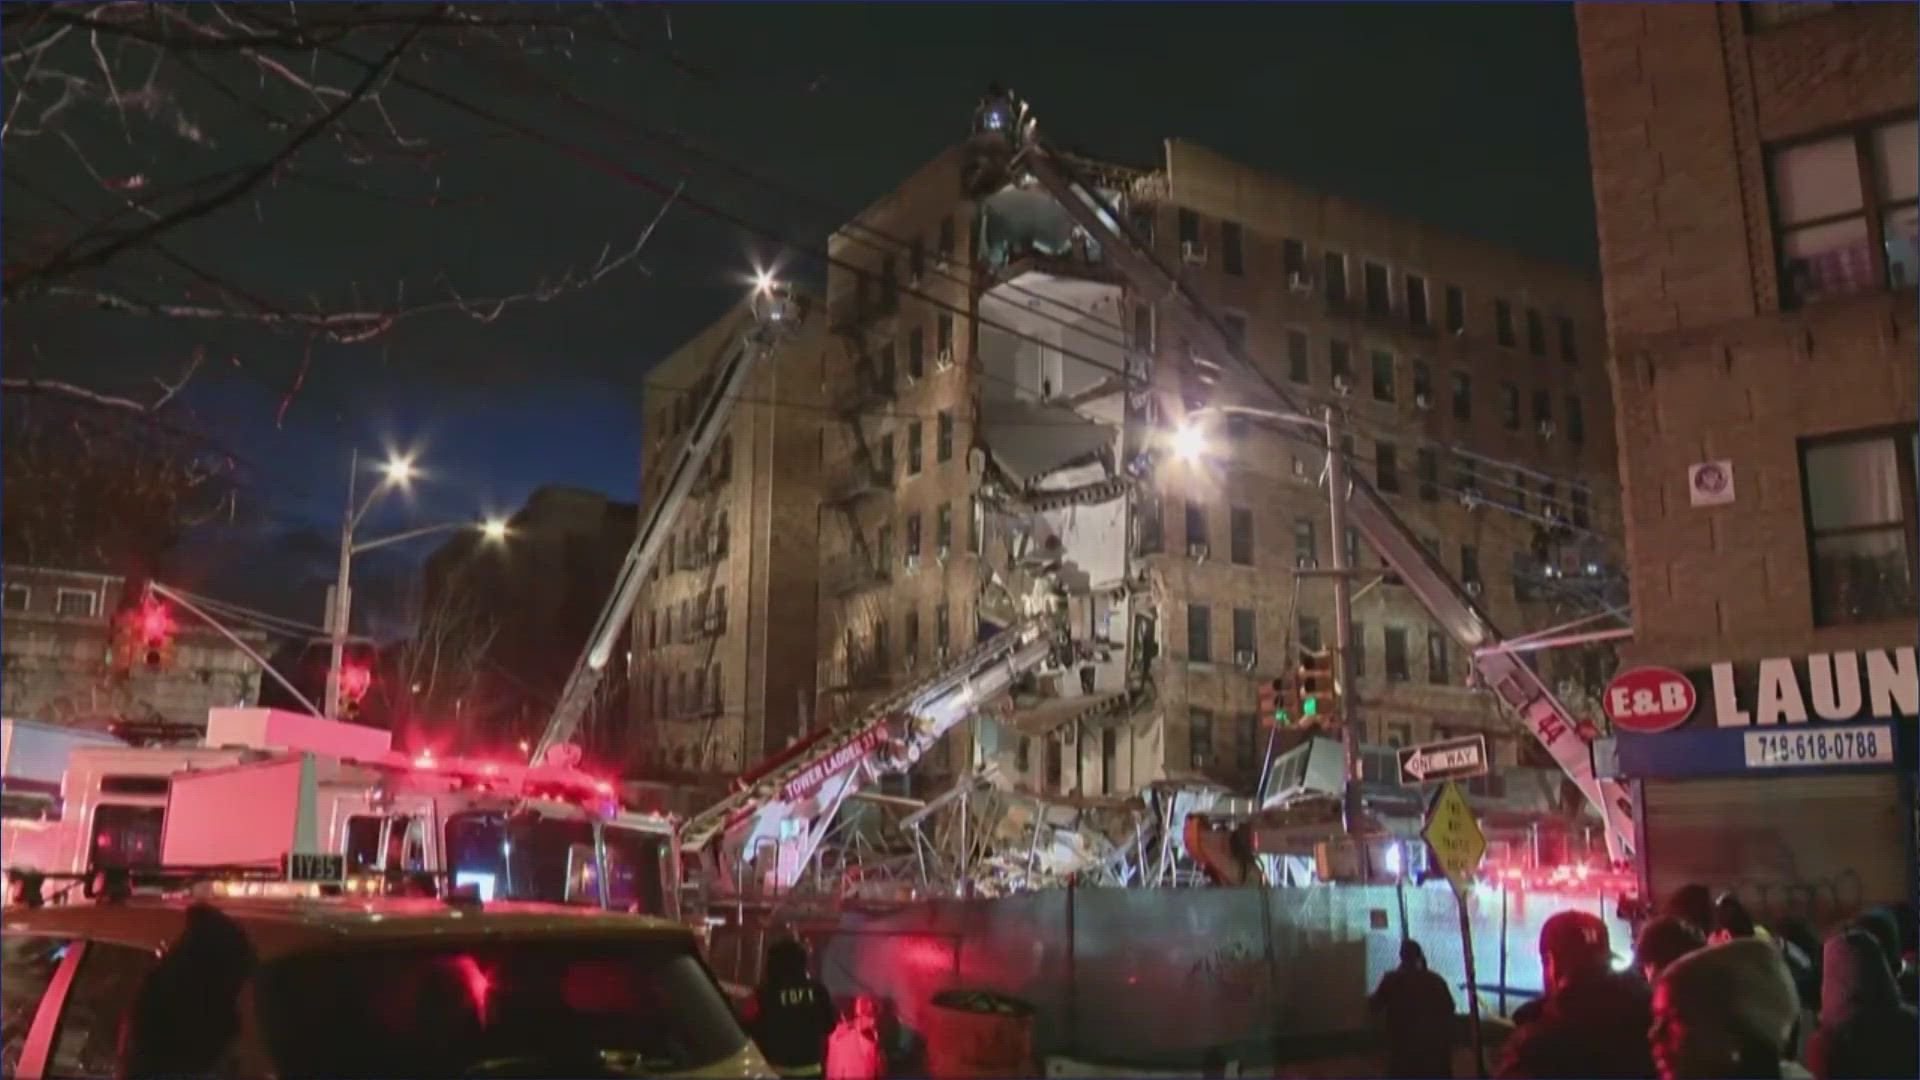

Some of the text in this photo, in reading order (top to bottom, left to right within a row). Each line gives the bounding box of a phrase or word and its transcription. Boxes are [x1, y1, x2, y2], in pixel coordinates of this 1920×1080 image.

[1611, 682, 1688, 718] E&B
[1711, 646, 1918, 728] LAUN
[1539, 713, 1567, 746] 44
[1758, 731, 1877, 762] 718-618-0788
[785, 764, 824, 799] TOWER
[822, 739, 864, 777] LADDER
[1411, 748, 1472, 774] ONE WAY
